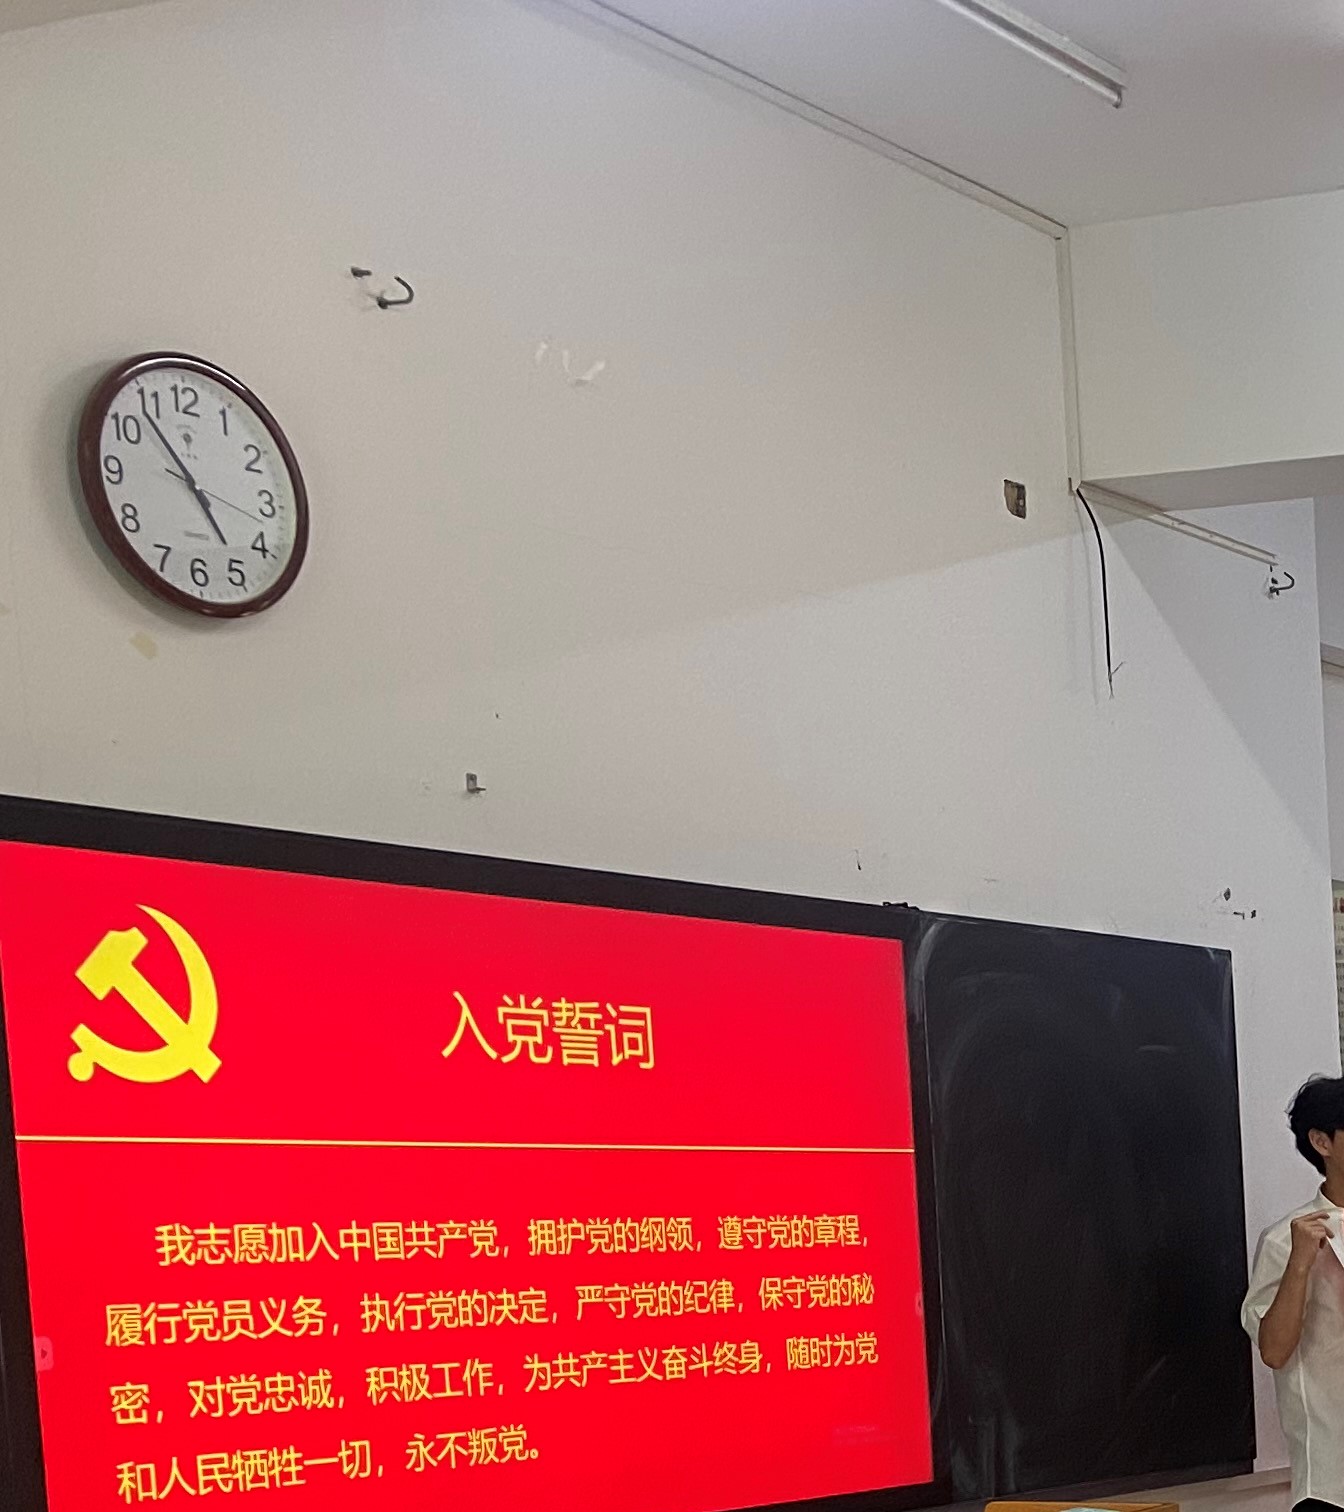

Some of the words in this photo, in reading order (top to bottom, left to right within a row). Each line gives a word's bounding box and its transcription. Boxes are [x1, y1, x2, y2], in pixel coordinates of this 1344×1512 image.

[137, 386, 160, 419] 11
[171, 384, 200, 418] 12
[111, 412, 141, 445] 10
[219, 406, 229, 437] 1
[104, 455, 123, 485] 9
[244, 444, 263, 473] 2
[121, 503, 140, 533] 8
[258, 490, 276, 518] 3
[153, 544, 172, 572] 7
[252, 531, 270, 559] 4
[190, 558, 209, 587] 6
[227, 559, 245, 587] 5
[441, 991, 655, 1069] 入党誓词
[155, 1214, 868, 1268] 我志愿加入中国共产党，拥护党的纲领，遵守党的章程，
[105, 1273, 874, 1347] 履行党员义务，执行党的决定，严守党的纪律，保守党的秘
[110, 1332, 879, 1425] 密，对党忠诚，积极工作，为共产主义奋斗终身，随时为党
[116, 1424, 540, 1504] 和人民牺牲一切，永不叛党。
